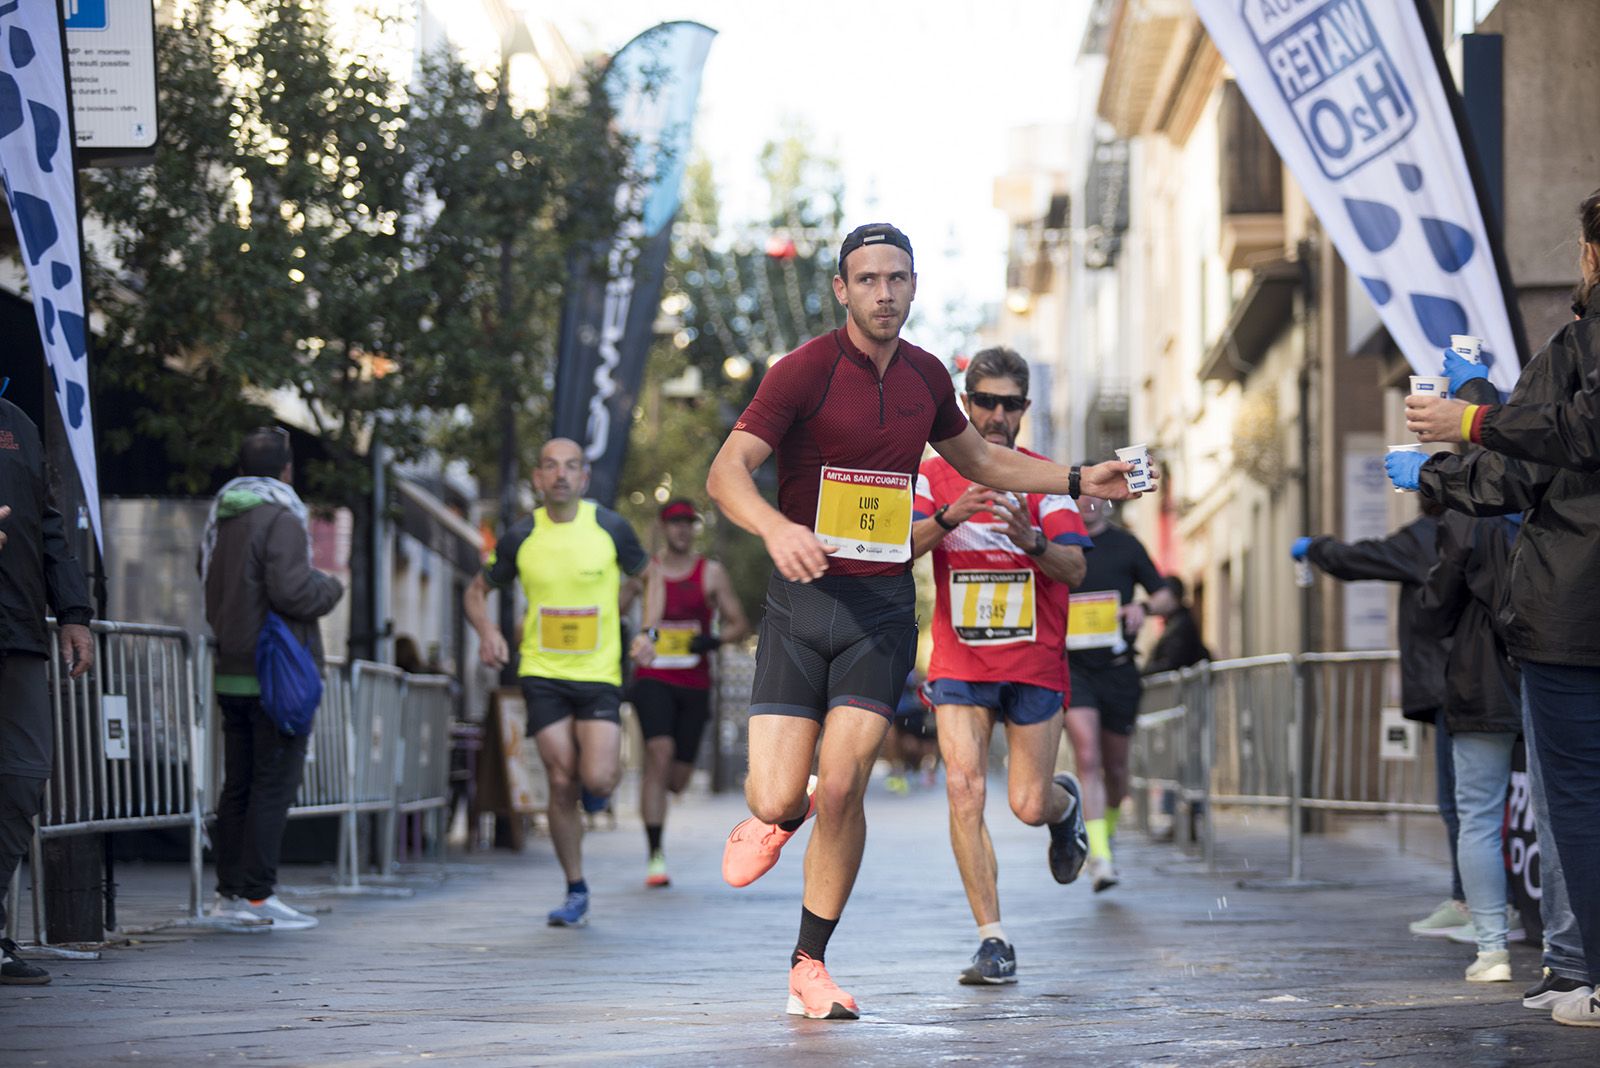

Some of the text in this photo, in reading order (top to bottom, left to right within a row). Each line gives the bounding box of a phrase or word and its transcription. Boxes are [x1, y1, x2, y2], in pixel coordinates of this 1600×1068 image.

[826, 471, 851, 482] MITJA
[853, 475, 875, 484] SANT
[875, 476, 899, 485] CUGAT
[859, 496, 879, 510] LUIS
[859, 513, 875, 531] 65
